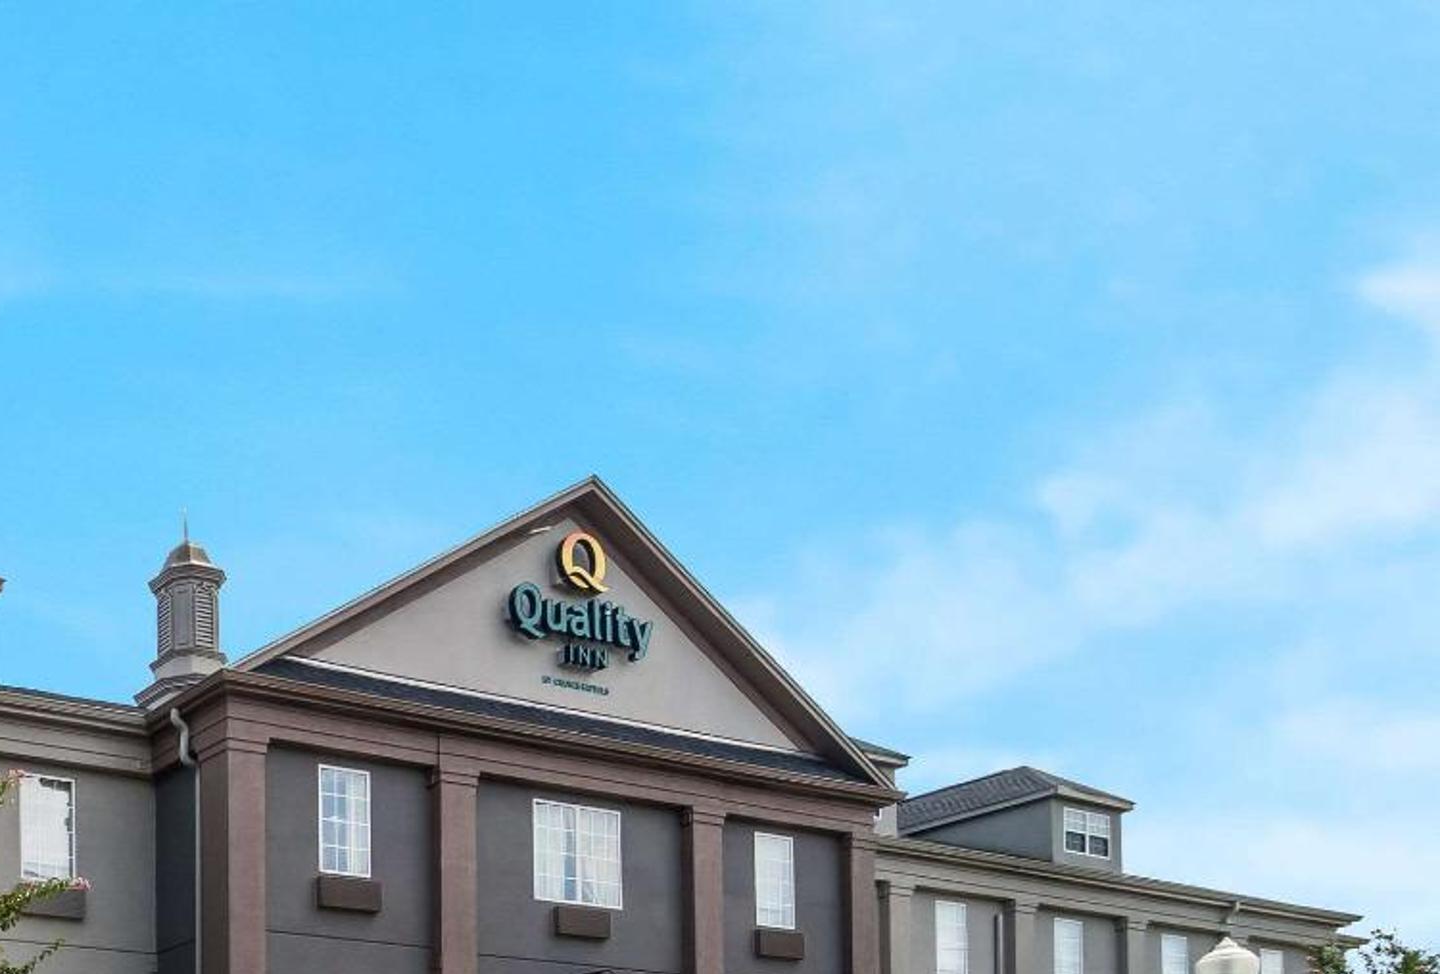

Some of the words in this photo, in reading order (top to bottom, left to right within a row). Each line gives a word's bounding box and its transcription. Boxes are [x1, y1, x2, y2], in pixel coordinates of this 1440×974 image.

[559, 532, 609, 592] Q
[511, 582, 653, 661] Quality
[565, 643, 609, 668] INN
